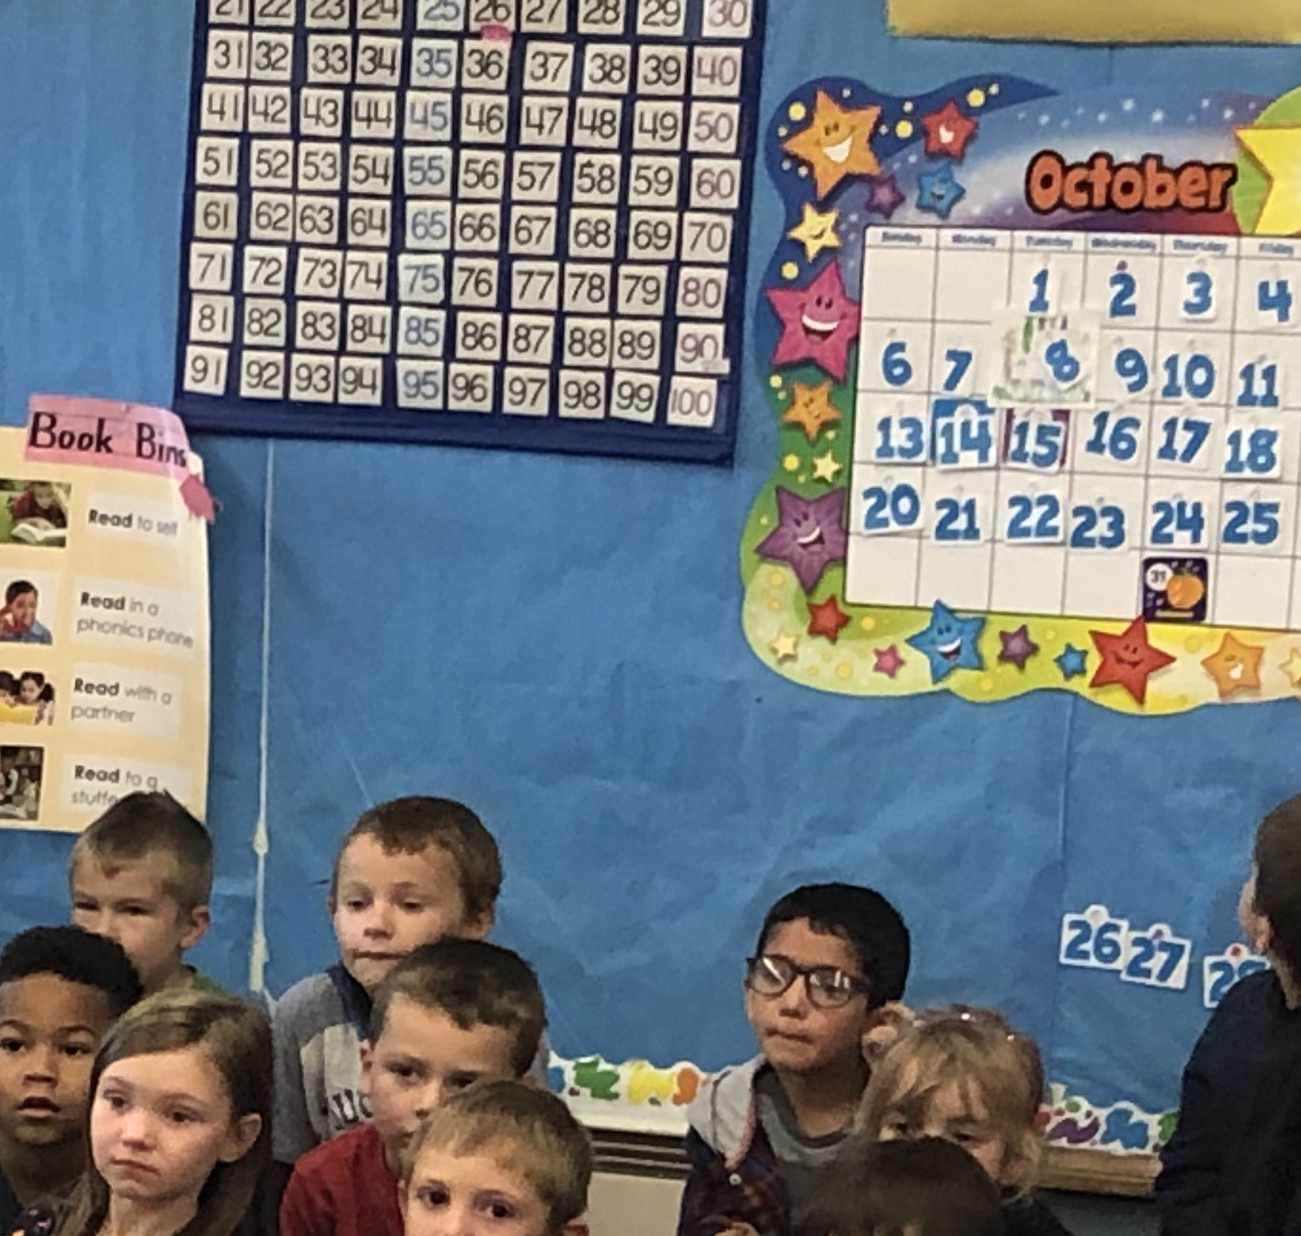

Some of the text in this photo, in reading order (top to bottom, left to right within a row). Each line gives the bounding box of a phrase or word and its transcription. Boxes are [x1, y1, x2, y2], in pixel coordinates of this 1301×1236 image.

[214, 39, 738, 86] 31 32 33 34 35 36 37 38 39 40
[207, 93, 734, 143] 41 42 43 44 45 46 47 48 49 50
[203, 146, 736, 200] 51 52 53 54 55 56 57 58 59 60
[1025, 148, 1238, 215] October
[203, 201, 727, 253] 61 62 63 64 65 66 67 68 69 70
[197, 253, 722, 309] 71 72 73 74 75 76 77 78 79 80
[1028, 269, 1292, 323] 1 2 3 4
[191, 355, 713, 417] 91 92 93 94 95 96 97 98 99 100
[882, 338, 1280, 408] 6 7 8 9 10 11
[29, 412, 187, 467] Book Bins
[875, 411, 1280, 474] 13 14 15 16 17 18
[88, 509, 178, 537] Read to self
[862, 483, 1280, 550] 20 21 22 23 24 25
[80, 592, 159, 617] Read in a
[76, 616, 194, 648] phonics phone
[70, 703, 136, 724] partner
[74, 678, 172, 706] Read with a
[74, 765, 120, 784] Read
[125, 770, 142, 787] to
[1063, 919, 1121, 965] 26
[1125, 935, 1186, 983] 27
